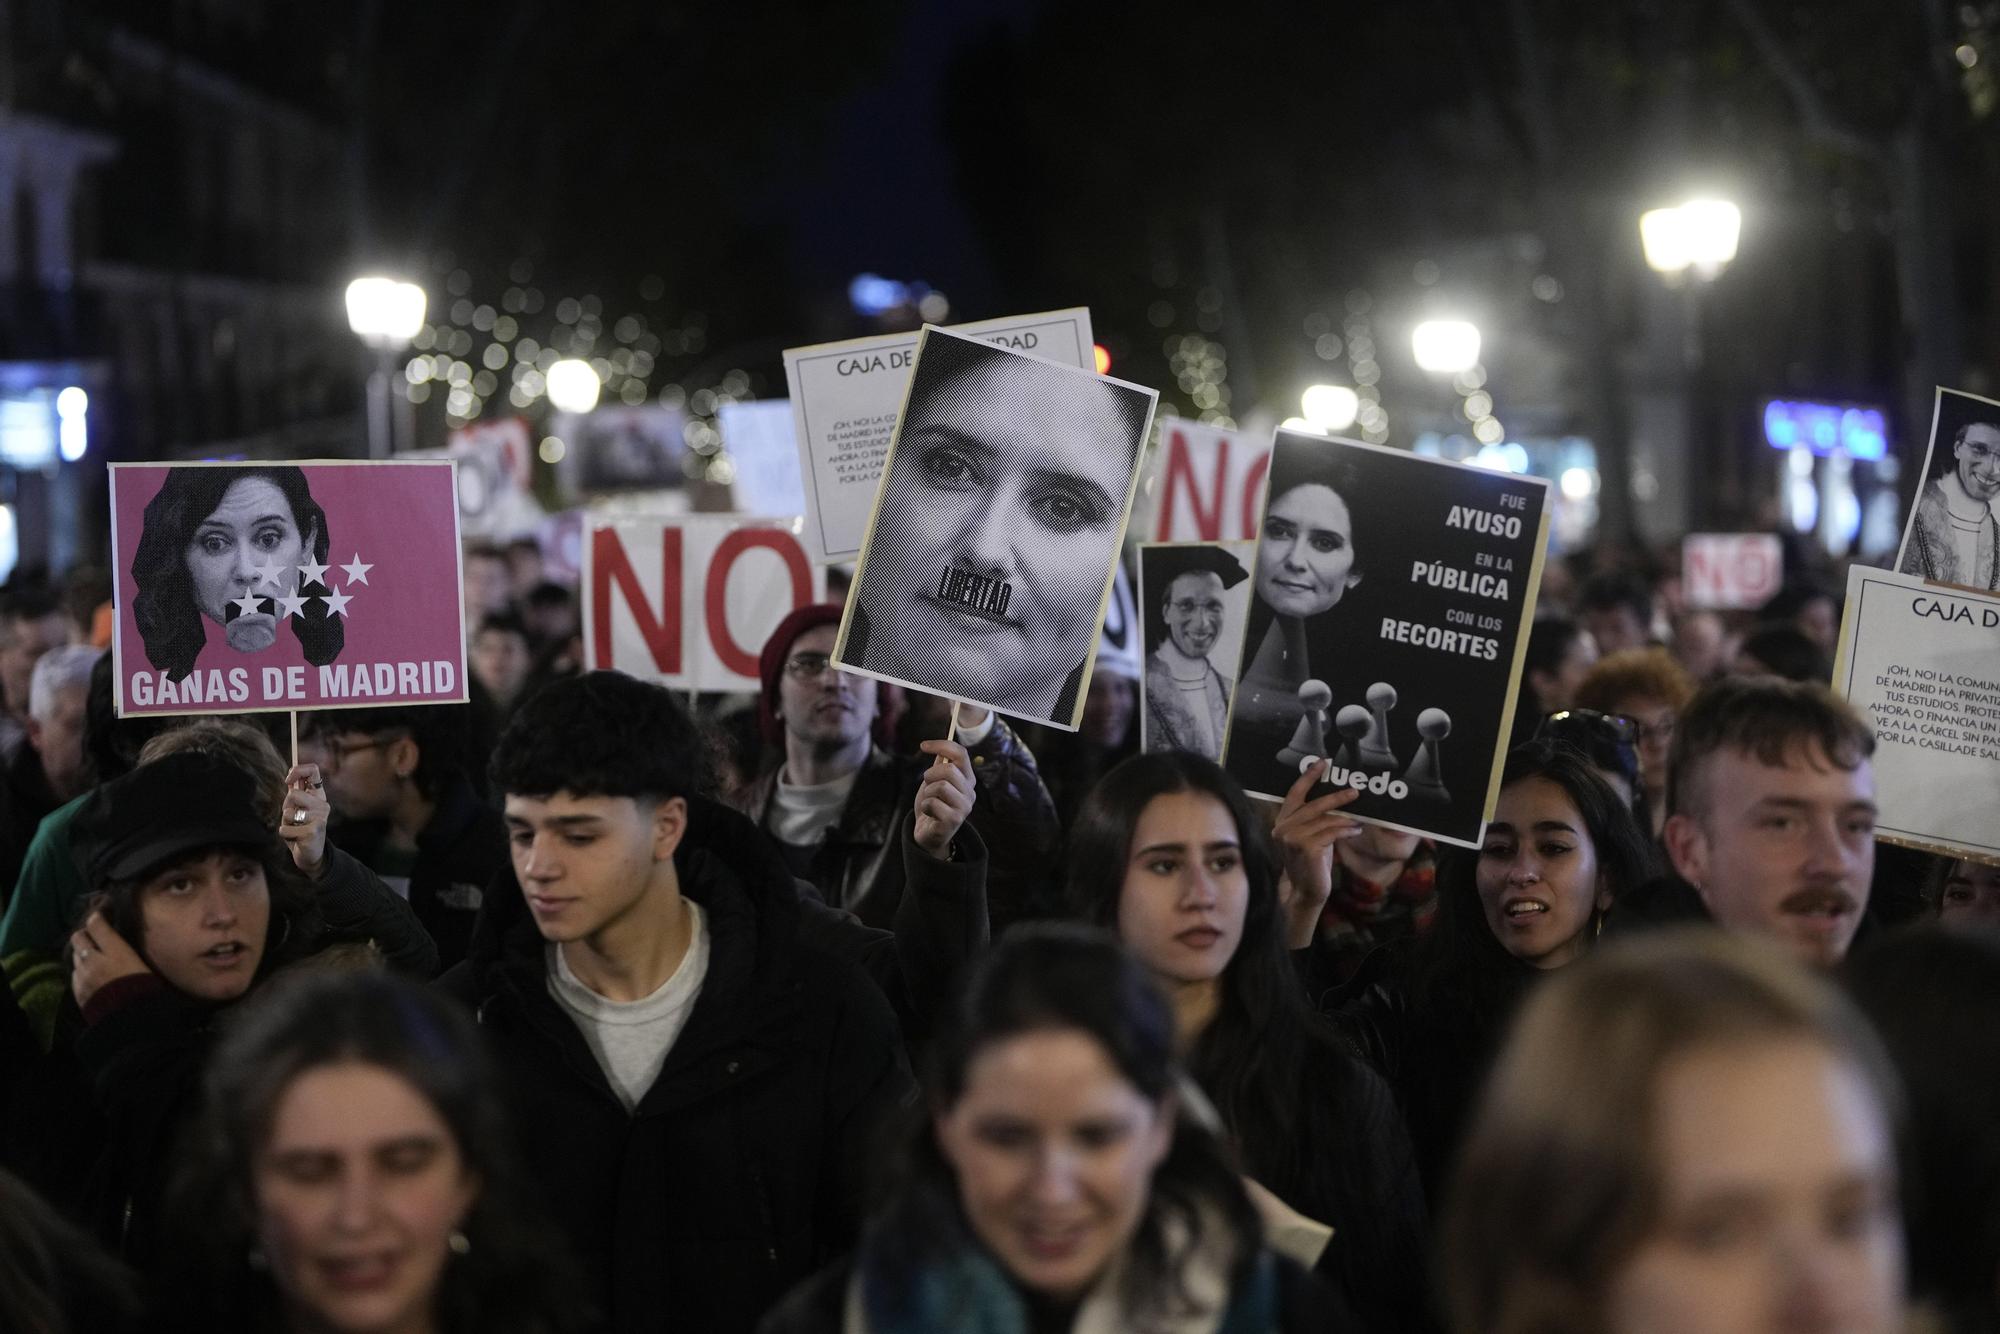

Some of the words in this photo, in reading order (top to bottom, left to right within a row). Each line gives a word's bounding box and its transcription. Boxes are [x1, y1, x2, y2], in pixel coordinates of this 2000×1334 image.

[837, 356, 886, 376] CAJA
[890, 350, 913, 369] DE
[871, 416, 882, 425] LA
[827, 433, 837, 442] DE
[839, 428, 872, 439] MADRID
[874, 427, 886, 435] HA
[827, 453, 858, 464] AHORA
[861, 450, 869, 458] O
[837, 441, 852, 451] TUS
[835, 464, 846, 473] VE
[855, 462, 867, 471] LA
[839, 474, 856, 484] POR
[857, 473, 869, 481] LA
[1499, 493, 1527, 510] FUE
[1445, 505, 1522, 540] AYUSO
[1474, 552, 1493, 568] EN
[1496, 557, 1513, 572] LA
[937, 565, 1013, 616] LIBERTAD
[1411, 560, 1509, 601] PÚBLICA
[592, 526, 814, 679] NO
[1912, 597, 1974, 625] CAJA
[1446, 608, 1474, 625] CON
[1477, 615, 1503, 632] LOS
[1380, 617, 1499, 661] RECORTES
[131, 667, 249, 706] GANAS
[262, 666, 306, 700] DE
[319, 660, 456, 698] MADRID
[1876, 676, 1890, 687] DE
[1892, 678, 1936, 694] MADRID
[1938, 686, 1956, 698] HA
[1914, 669, 1936, 681] NO!
[1939, 672, 1954, 684] LA
[1886, 691, 1905, 702] TUS
[1907, 694, 1961, 713] ESTUDIOS.
[1869, 703, 1911, 718] AHORA
[1913, 709, 1924, 720] O
[1926, 711, 1977, 729] FINANCIA
[1980, 721, 1996, 732] UN
[1876, 716, 1889, 727] VE
[1891, 719, 1900, 730] A
[1903, 721, 1918, 733] LA
[1962, 732, 1980, 743] SIN
[1876, 730, 1899, 743] POR
[1901, 734, 1916, 746] LA
